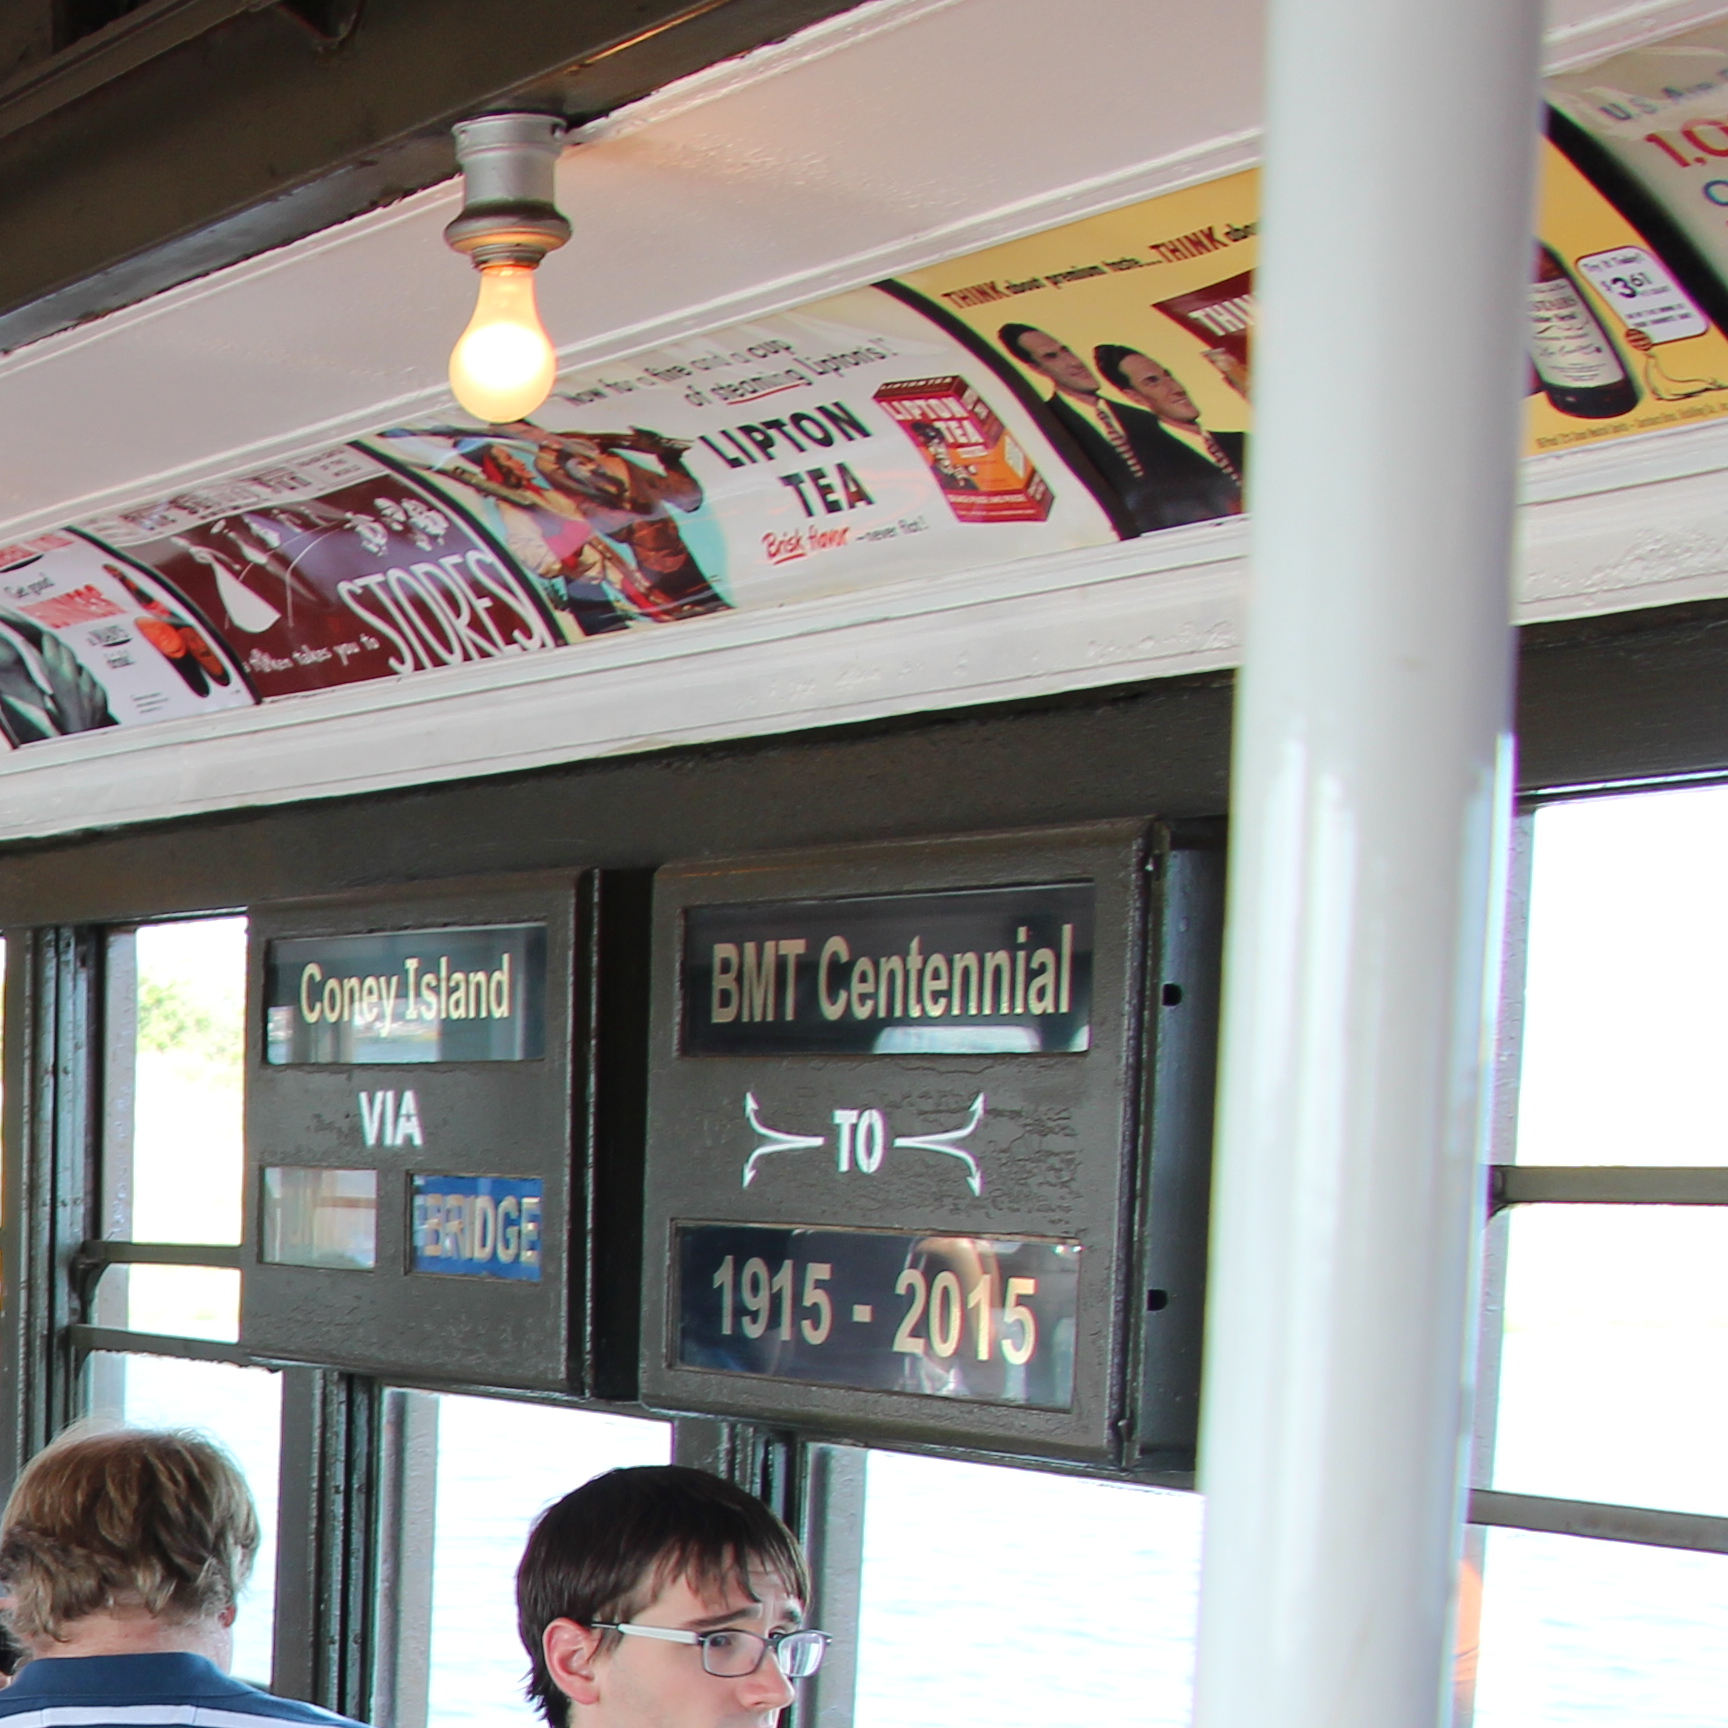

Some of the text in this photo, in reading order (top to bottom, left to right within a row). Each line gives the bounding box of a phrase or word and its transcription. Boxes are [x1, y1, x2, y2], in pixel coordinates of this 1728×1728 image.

[941, 281, 1008, 309] THINK
[1148, 225, 1230, 264] THINK
[747, 338, 797, 364] cup
[685, 387, 713, 407] of
[711, 367, 813, 402] steaming
[880, 396, 970, 420] LIPTON
[698, 401, 873, 469] LIPTON
[933, 420, 985, 444] TEA
[779, 462, 875, 518] TEA
[762, 528, 807, 559] Brisk
[806, 526, 850, 551] flavor
[337, 549, 556, 677] STORES
[294, 643, 332, 665] takes
[333, 641, 360, 666] you
[360, 634, 380, 650] to
[300, 952, 512, 1037] Coney Island
[711, 923, 1074, 1024] BMT Centennial
[358, 1090, 423, 1147] VIA
[833, 1108, 886, 1175] TO
[422, 1193, 542, 1267] BRIDGE
[713, 1255, 833, 1346] 1915
[893, 1267, 1037, 1365] 2015
